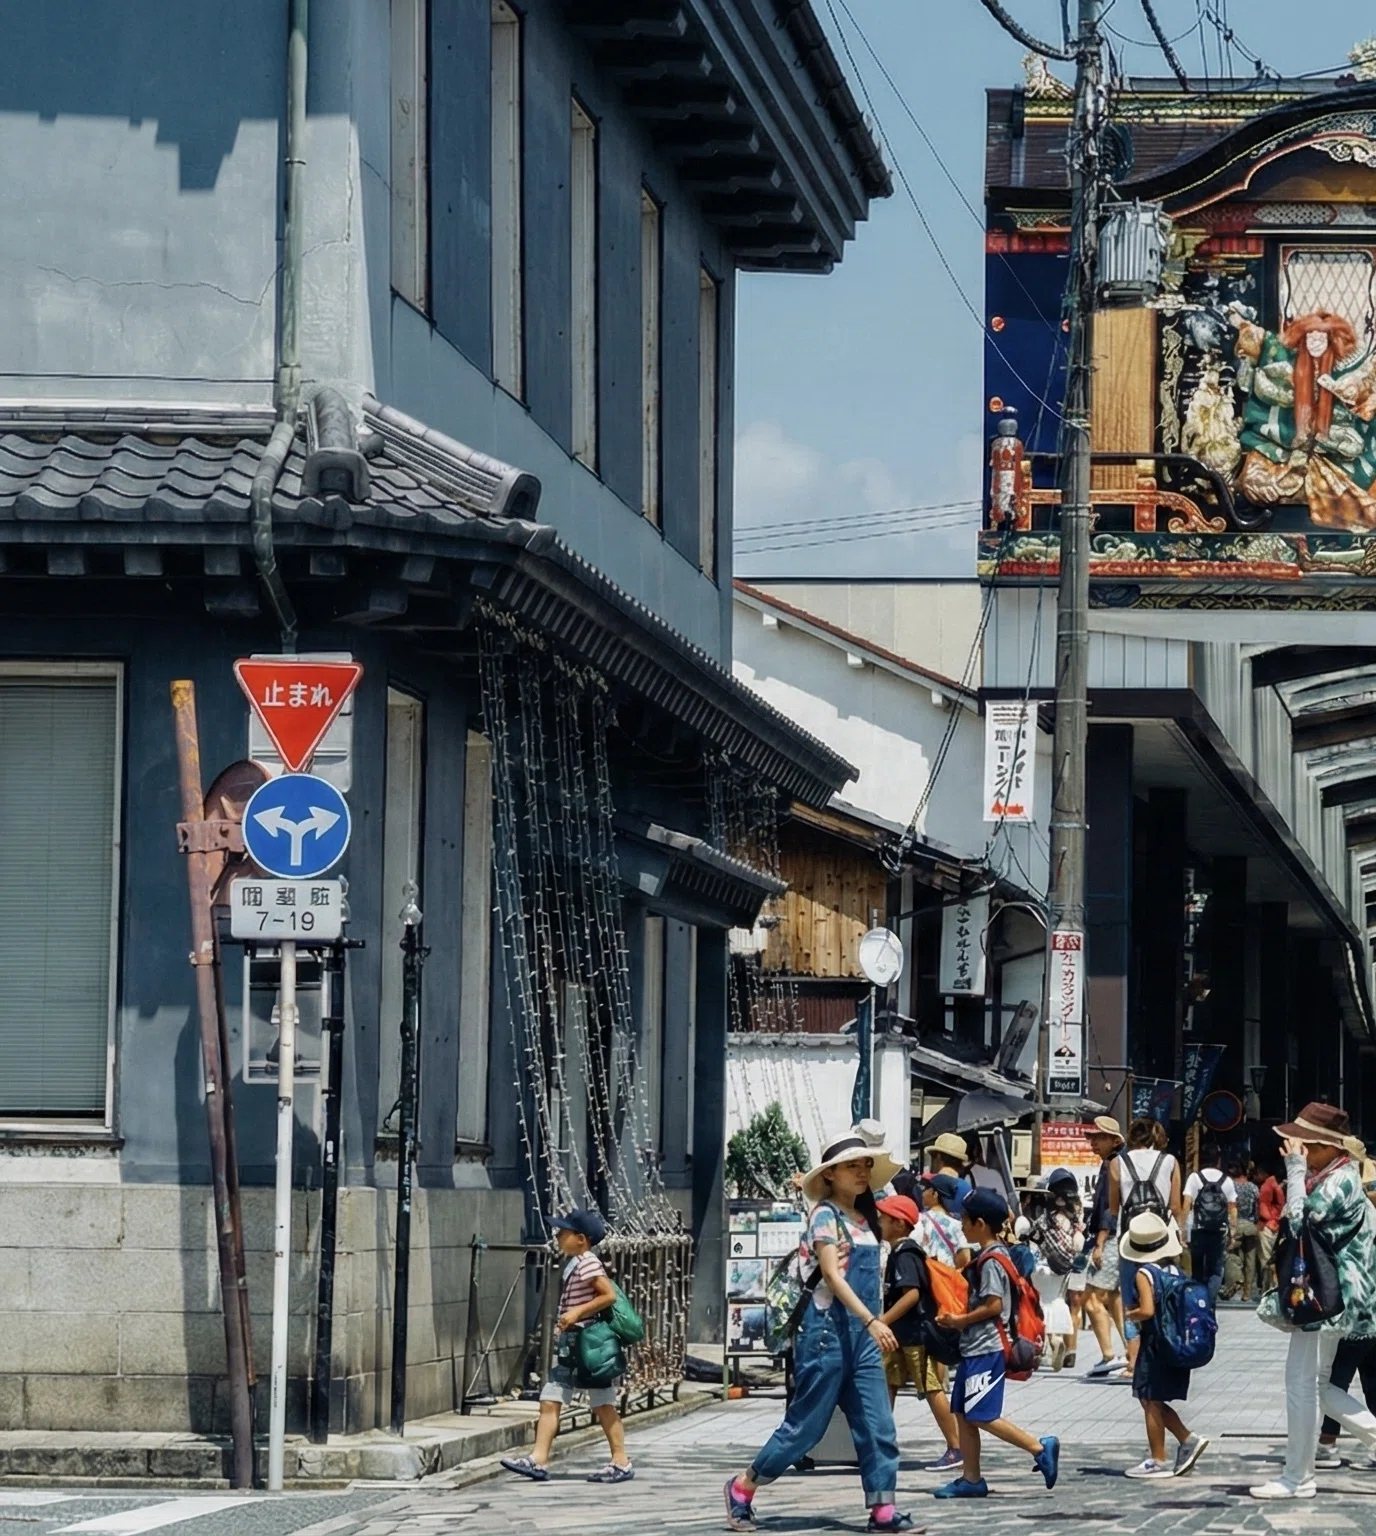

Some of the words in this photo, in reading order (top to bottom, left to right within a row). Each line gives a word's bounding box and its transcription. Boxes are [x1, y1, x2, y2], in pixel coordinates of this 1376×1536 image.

[261, 680, 334, 707] 止まれ
[256, 911, 315, 931] 7-19
